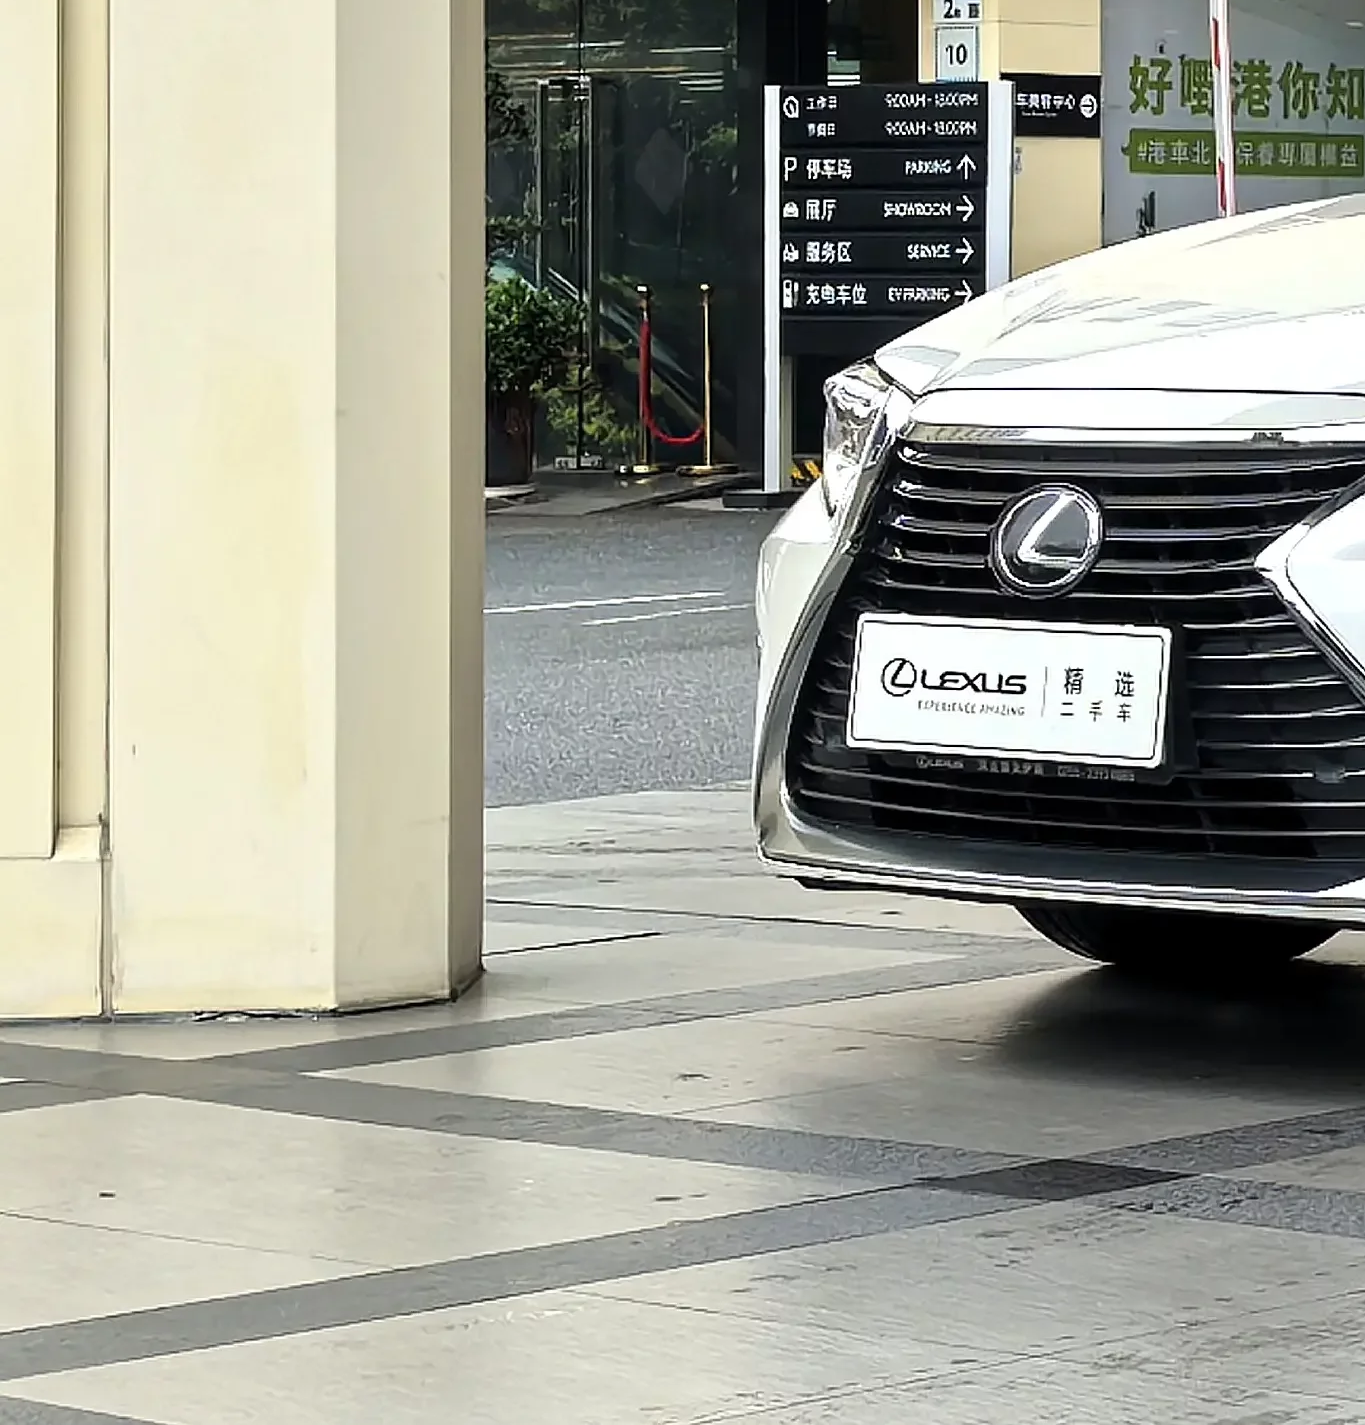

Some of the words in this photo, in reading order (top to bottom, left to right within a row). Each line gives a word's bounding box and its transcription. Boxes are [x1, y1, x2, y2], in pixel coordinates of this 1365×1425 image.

[945, 43, 967, 65] 10
[806, 158, 852, 180] 停车场
[905, 159, 951, 175] PARKING
[806, 199, 837, 221] 展厅
[806, 242, 852, 263] 服务区
[907, 244, 951, 260] SERVICE
[806, 283, 868, 305] 充电车位
[920, 668, 1027, 694] LEXUS
[1063, 666, 1135, 697] 精选
[918, 699, 976, 714] EXPERIENCE
[979, 703, 1025, 717] AMAZING
[1060, 700, 1132, 722] 二手车
